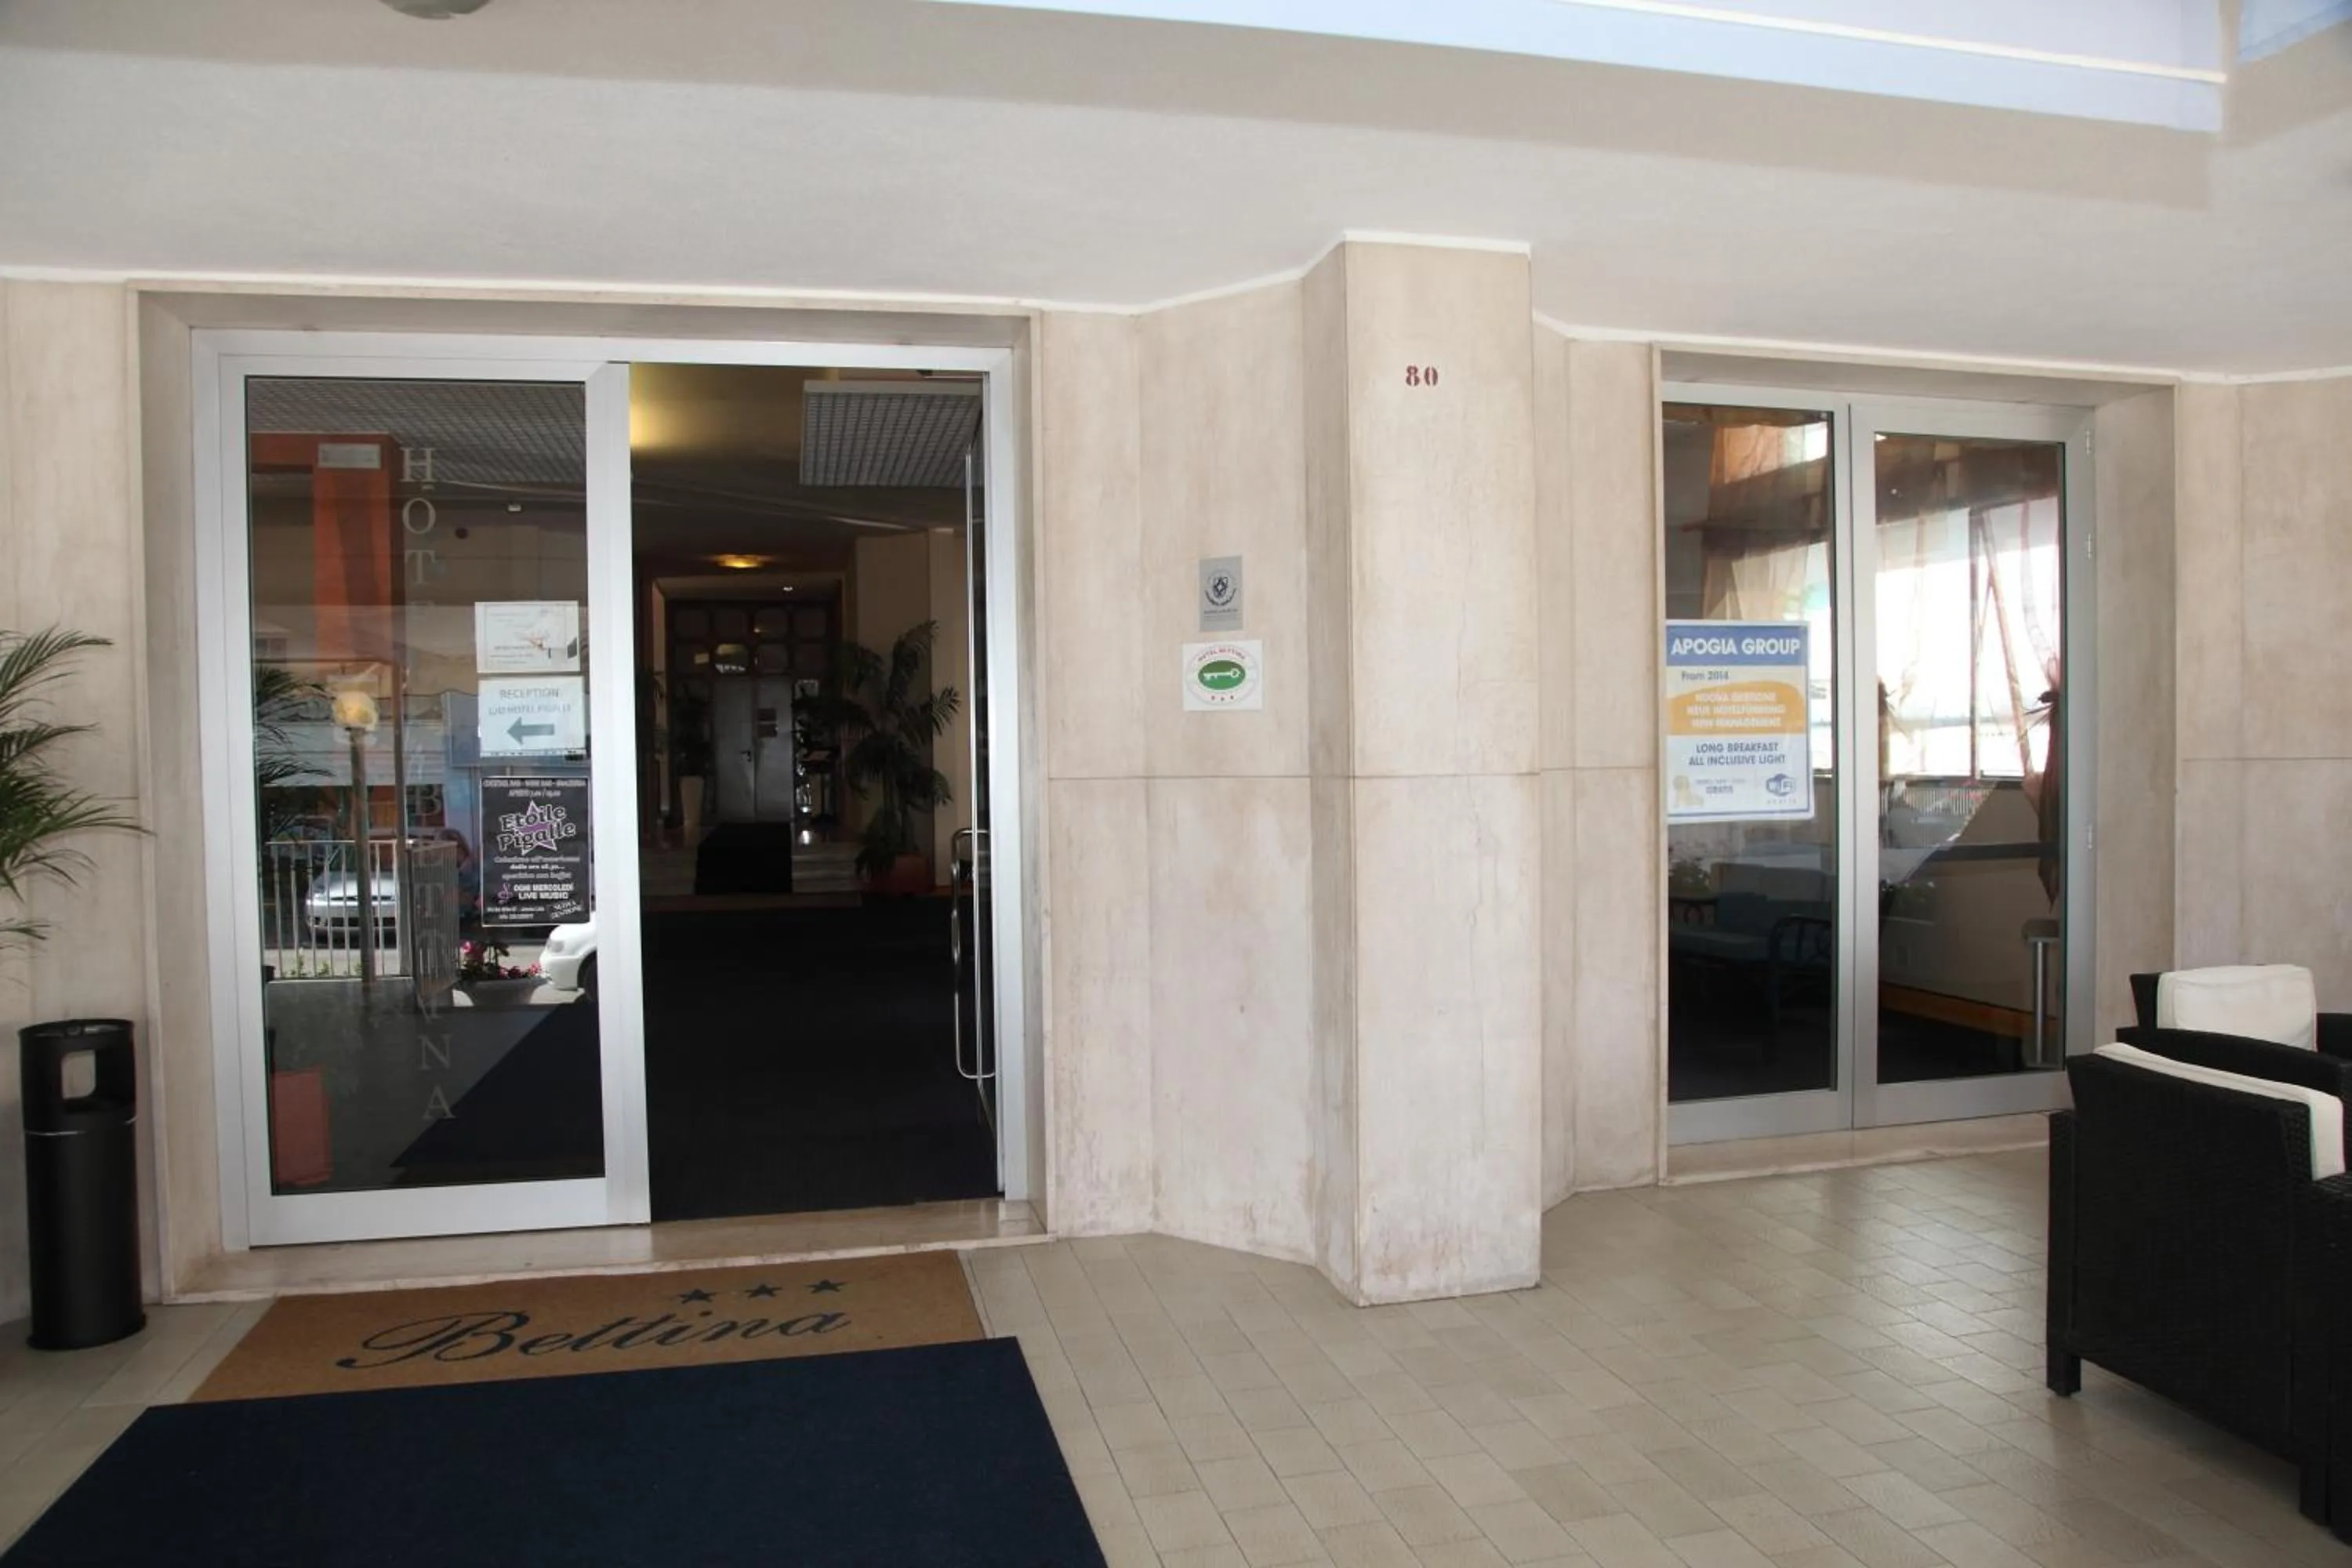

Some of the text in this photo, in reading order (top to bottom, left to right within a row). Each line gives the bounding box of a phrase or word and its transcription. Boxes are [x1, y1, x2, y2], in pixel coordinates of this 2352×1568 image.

[1406, 365, 1438, 387] 80
[1671, 637, 1801, 655] APOGIA GROUP
[1682, 670, 1729, 681] From 2014
[499, 688, 560, 699] RECEPTION
[1696, 742, 1779, 753] LONG BREAKFAST
[1689, 754, 1787, 766] ALL INCLUSIVE LIGHT
[499, 804, 567, 831] Etoile
[496, 822, 576, 852] Pigalle
[518, 891, 568, 900] LIVE MUSIC
[335, 1308, 852, 1369] Bettina
